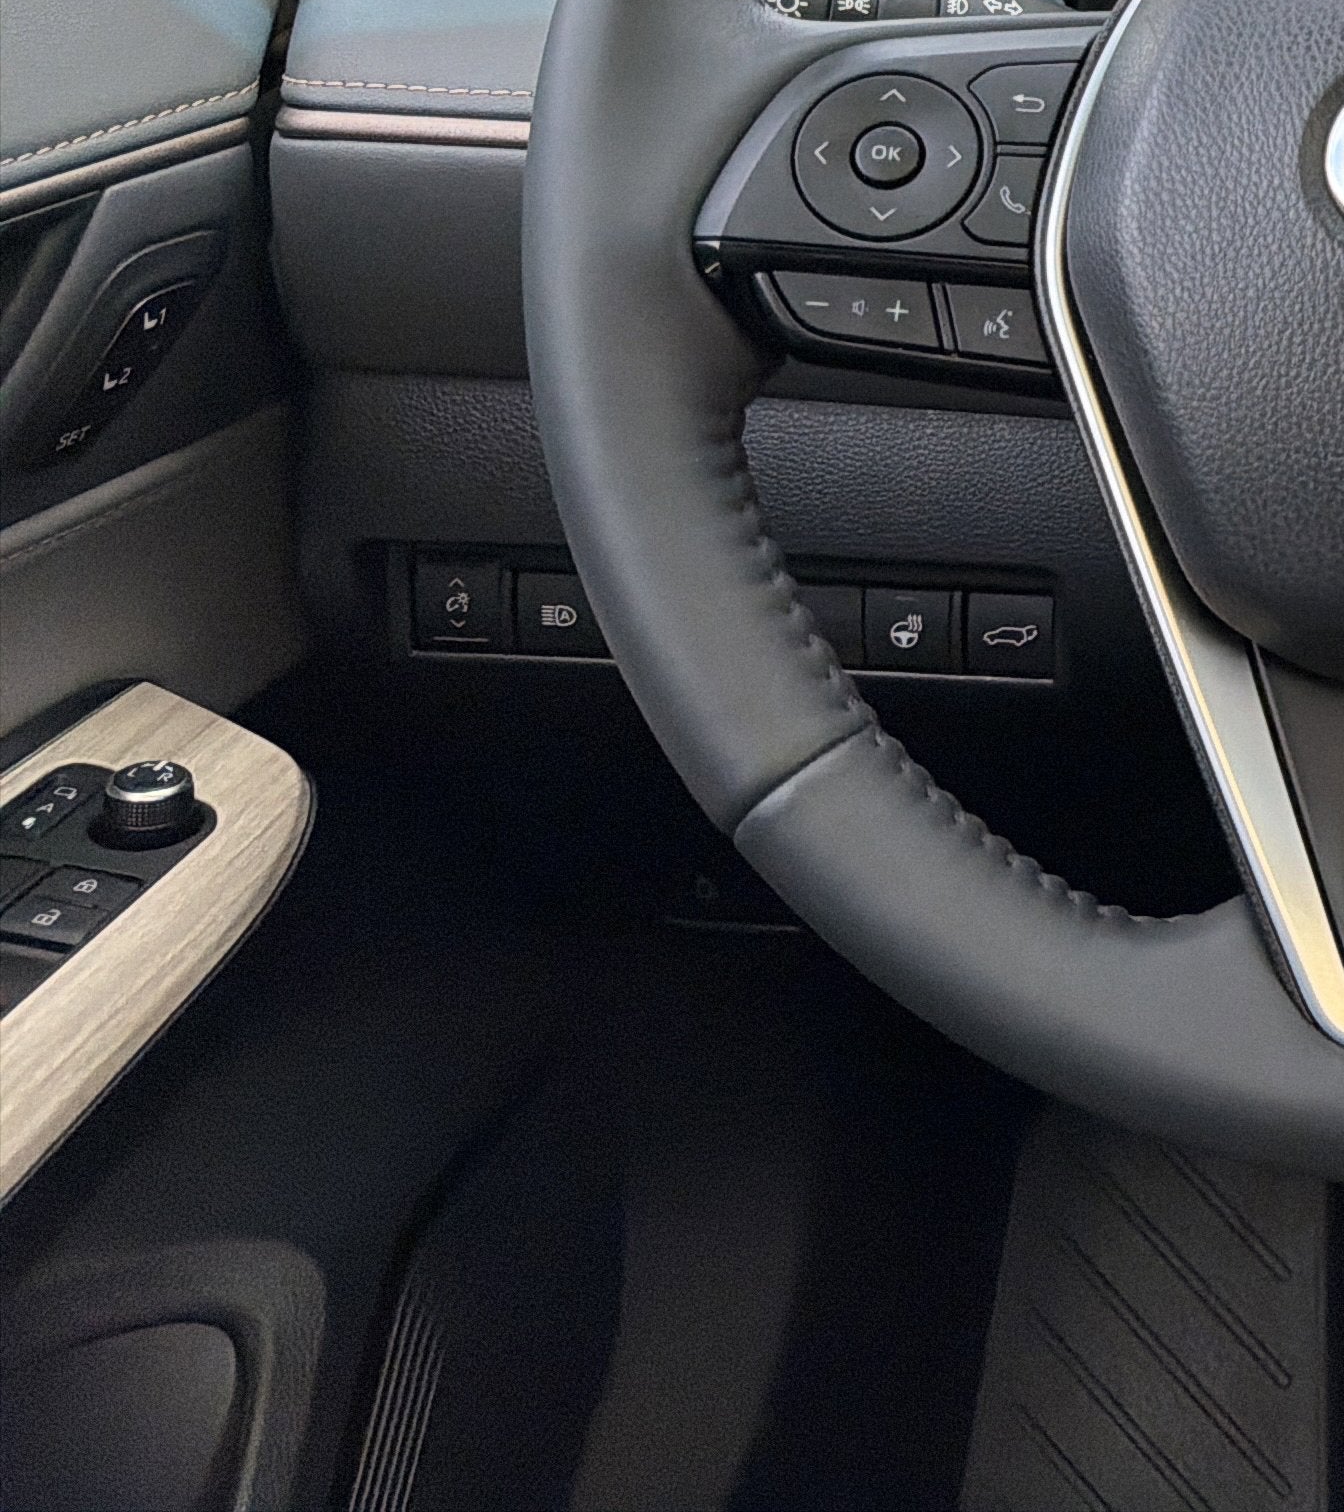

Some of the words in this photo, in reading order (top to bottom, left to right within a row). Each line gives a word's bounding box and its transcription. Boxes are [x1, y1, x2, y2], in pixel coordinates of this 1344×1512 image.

[871, 143, 902, 162] OK
[117, 366, 133, 386] 2
[55, 424, 91, 452] SET
